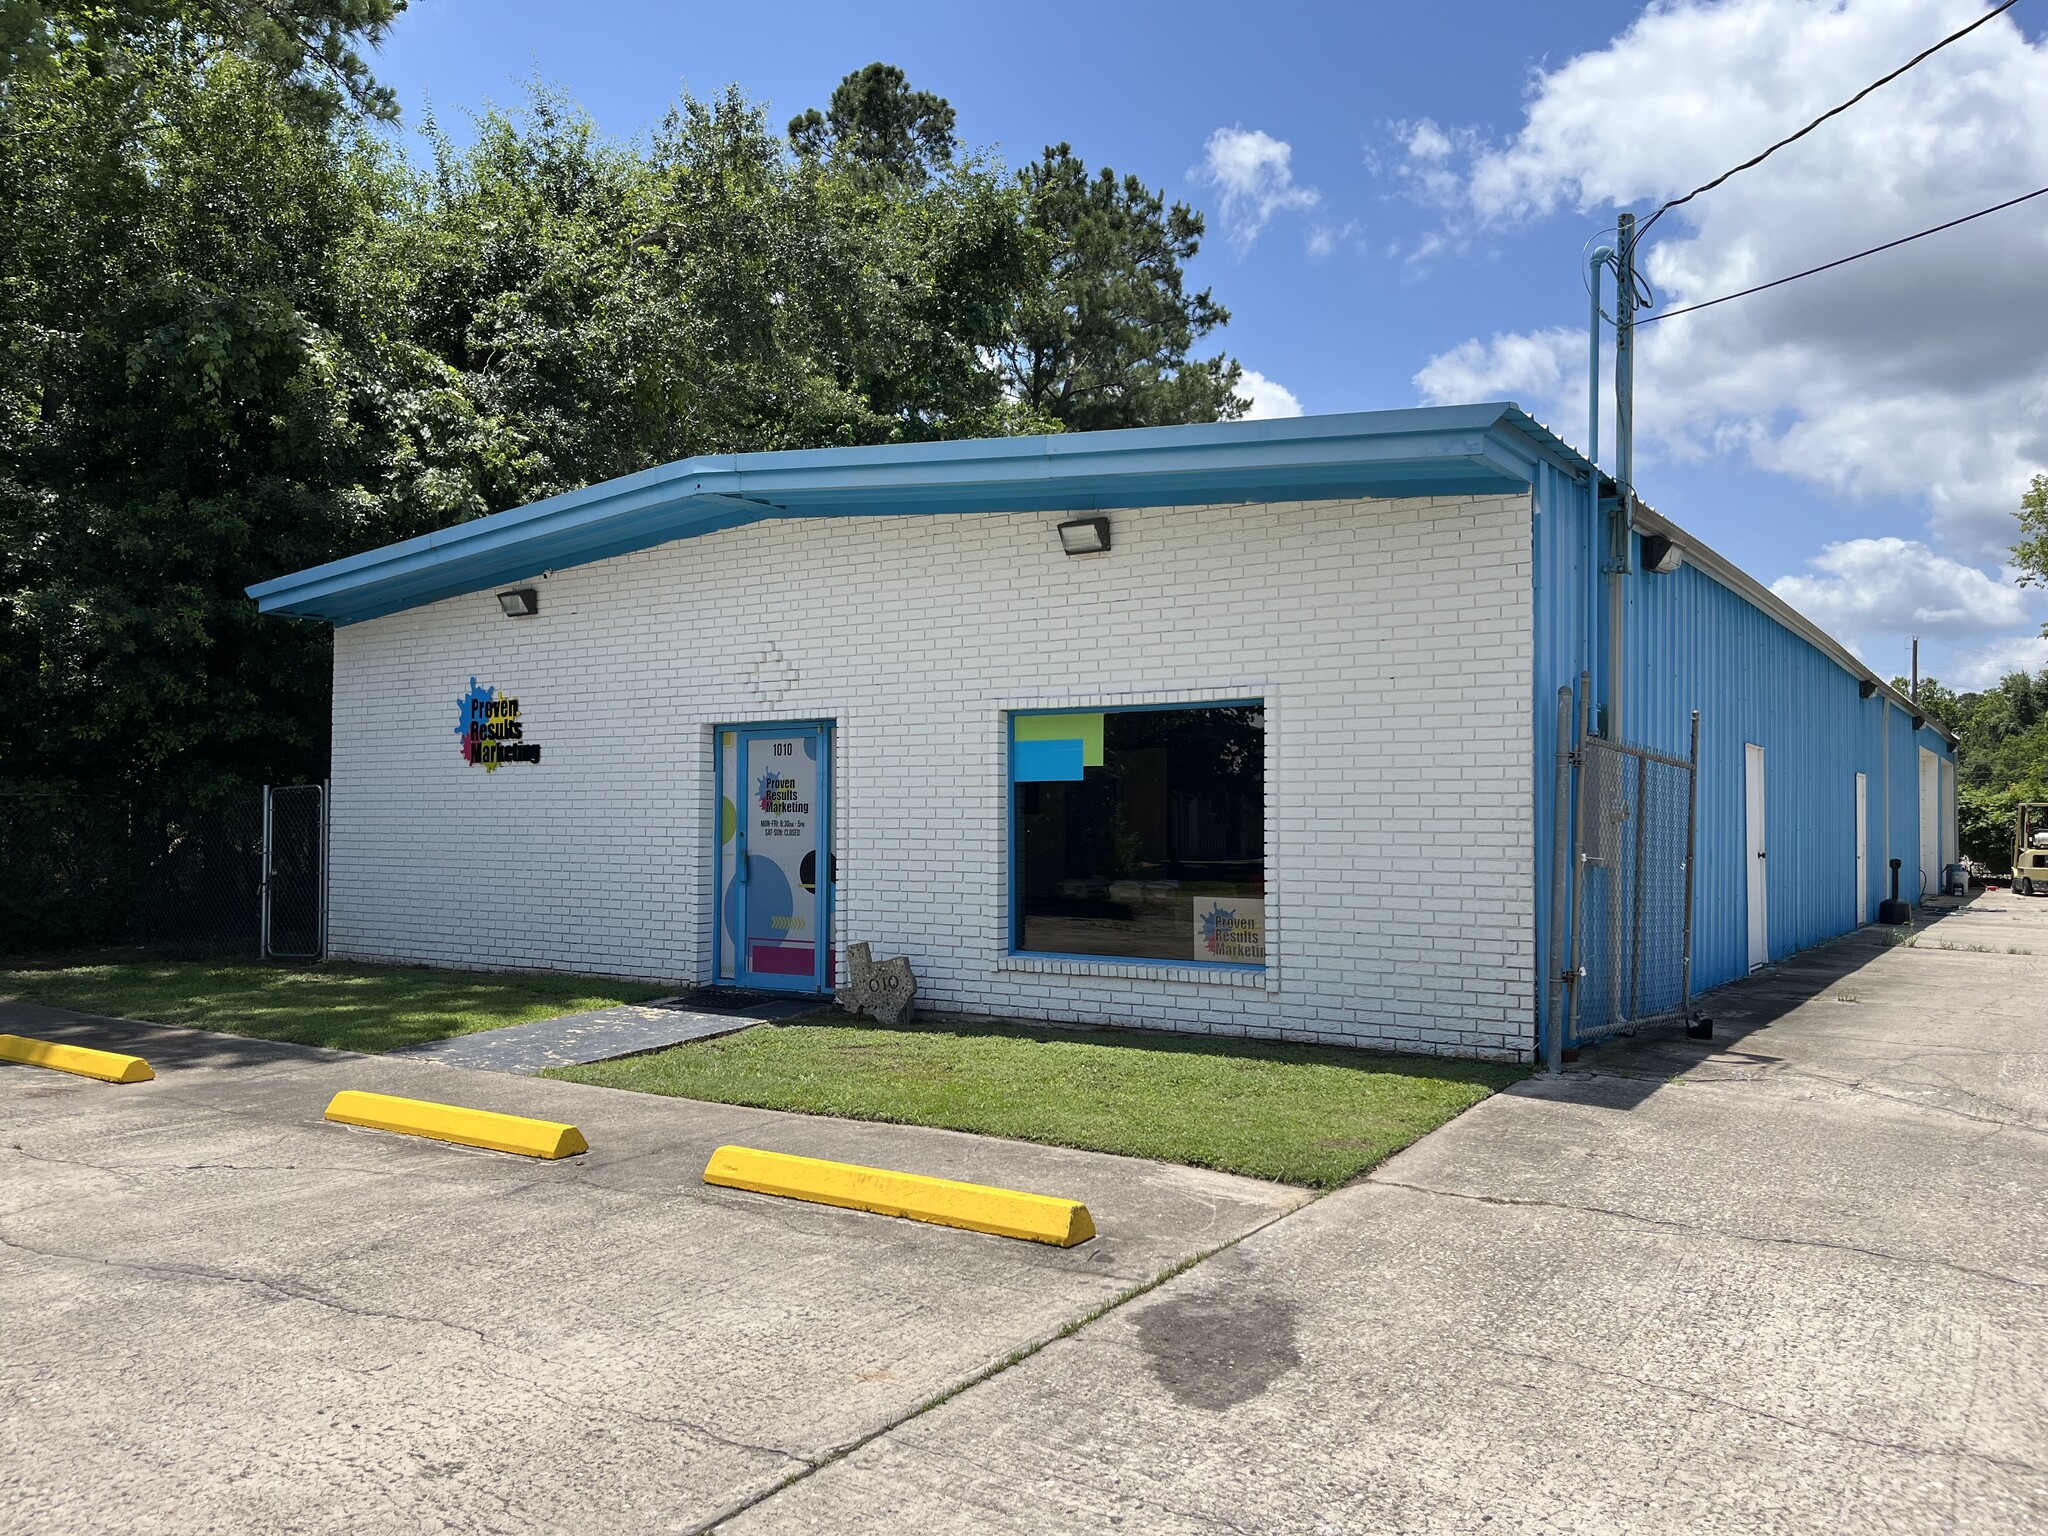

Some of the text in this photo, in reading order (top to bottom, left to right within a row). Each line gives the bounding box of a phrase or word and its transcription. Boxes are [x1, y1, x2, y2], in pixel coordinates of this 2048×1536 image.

[471, 698, 519, 718] Proven
[471, 719, 523, 740] Results
[471, 741, 541, 764] Marketing
[773, 743, 792, 756] 1010
[766, 778, 795, 789] Proven
[766, 790, 798, 801] Results
[766, 801, 809, 814] Marketing
[1215, 916, 1255, 930] Proven
[1215, 929, 1259, 944] Results
[1215, 943, 1265, 958] Marketin
